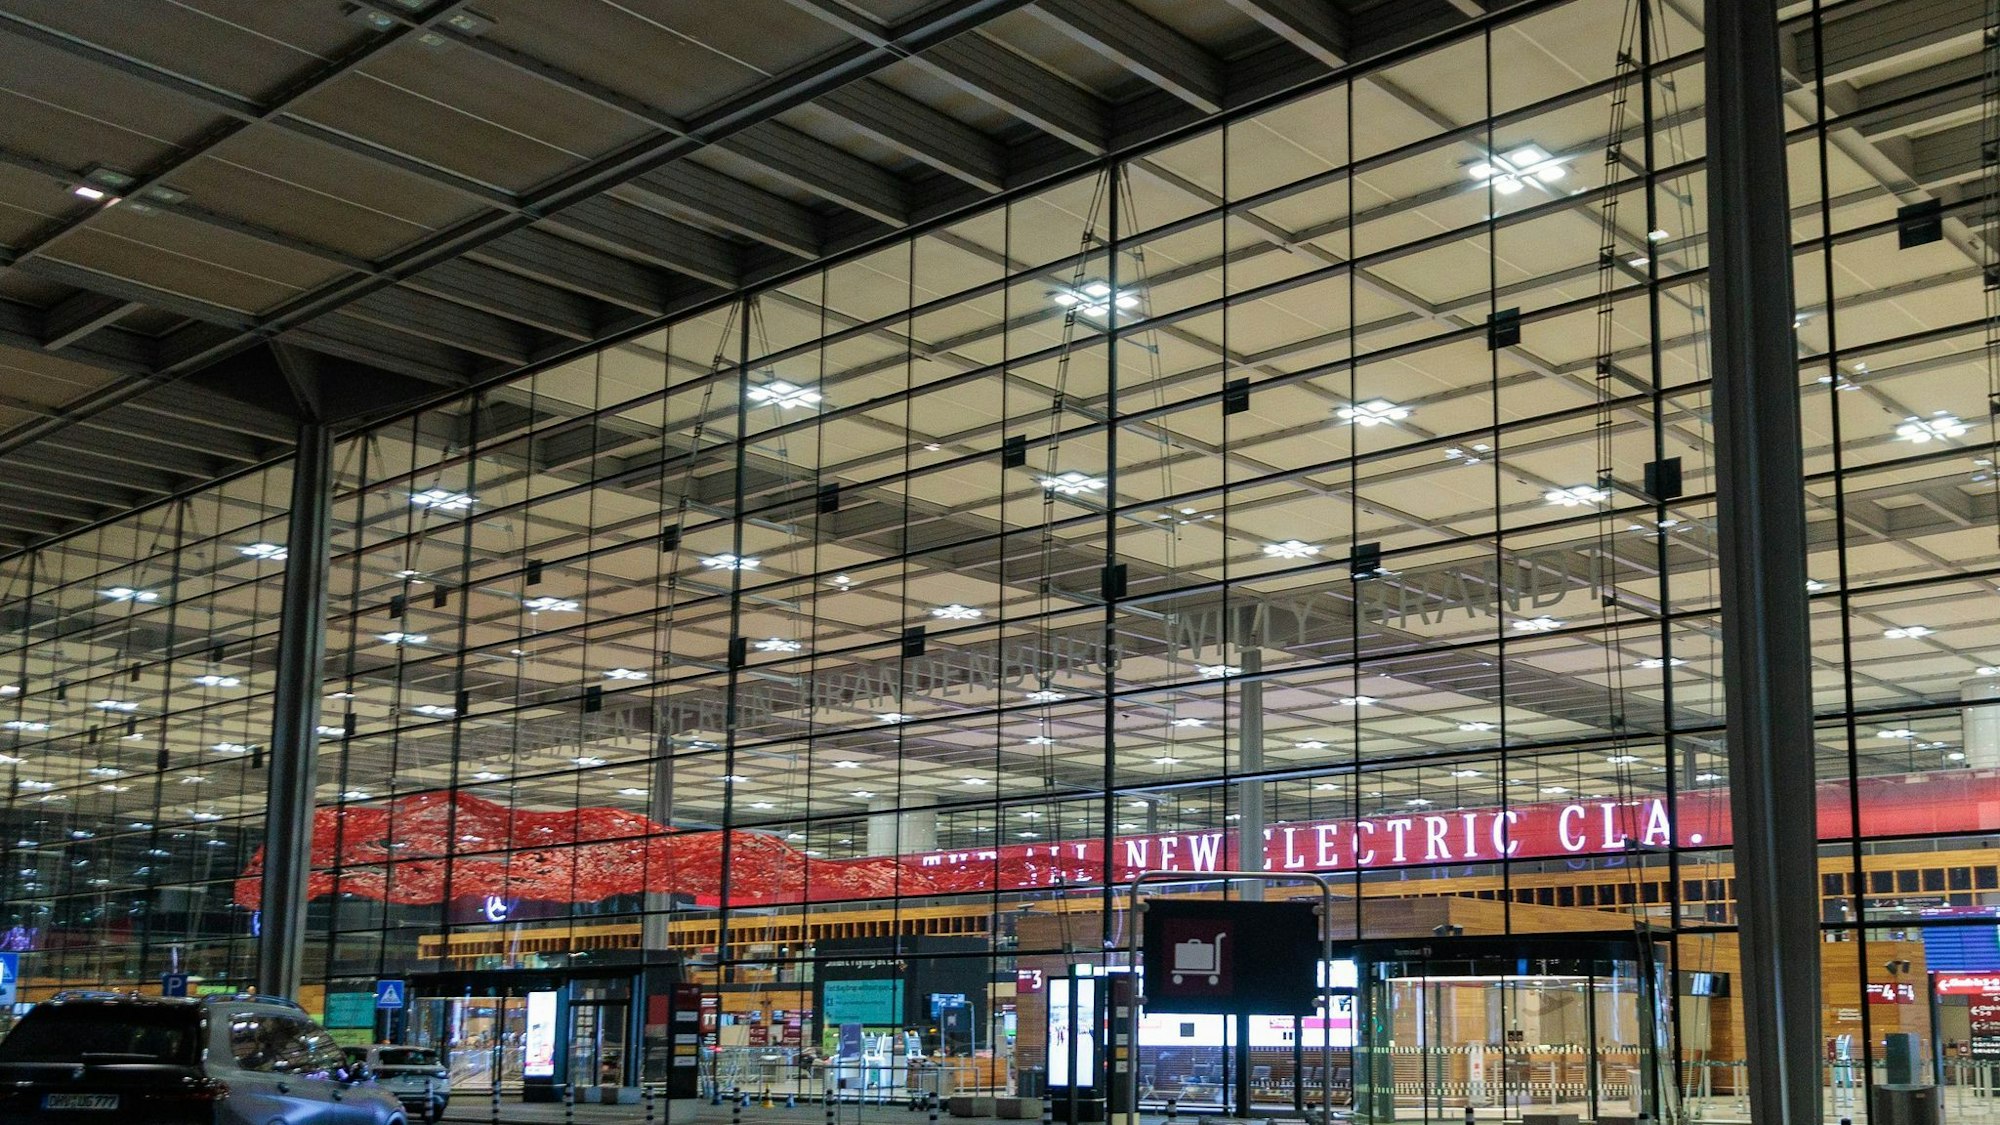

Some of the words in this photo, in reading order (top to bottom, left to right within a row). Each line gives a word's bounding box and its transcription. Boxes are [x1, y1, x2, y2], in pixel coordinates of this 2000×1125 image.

[803, 633, 1123, 717] BRANDENBURG
[1165, 594, 1318, 662] WILLY
[1359, 543, 1609, 629] BRANDT
[1125, 832, 1225, 879] NEW
[167, 977, 182, 996] P
[1031, 969, 1042, 989] 3
[1881, 984, 1896, 1001] 4
